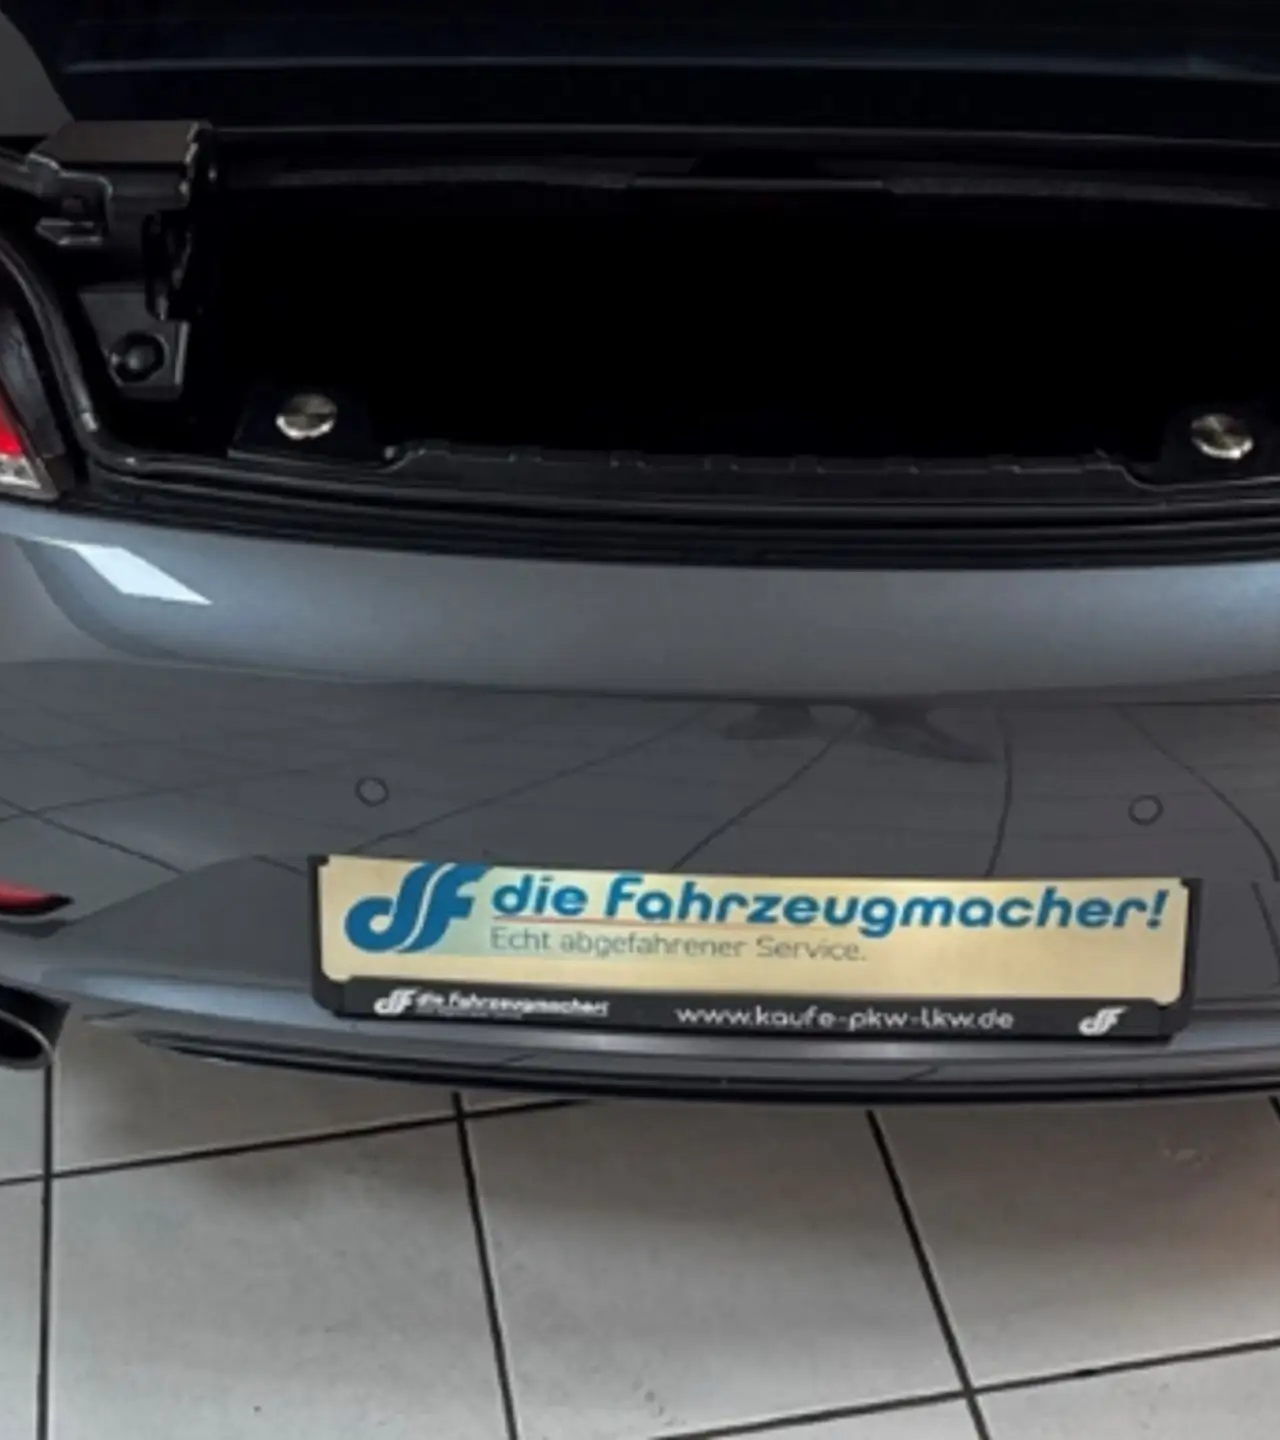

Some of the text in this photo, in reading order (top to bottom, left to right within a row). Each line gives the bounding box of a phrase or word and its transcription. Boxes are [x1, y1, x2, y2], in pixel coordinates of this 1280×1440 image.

[491, 871, 1169, 938] die Fahrzeugmacher!
[490, 926, 867, 962] Echt abgefahrener Service.
[674, 1004, 1015, 1032] www.kaufe-pkw-lkw.de
